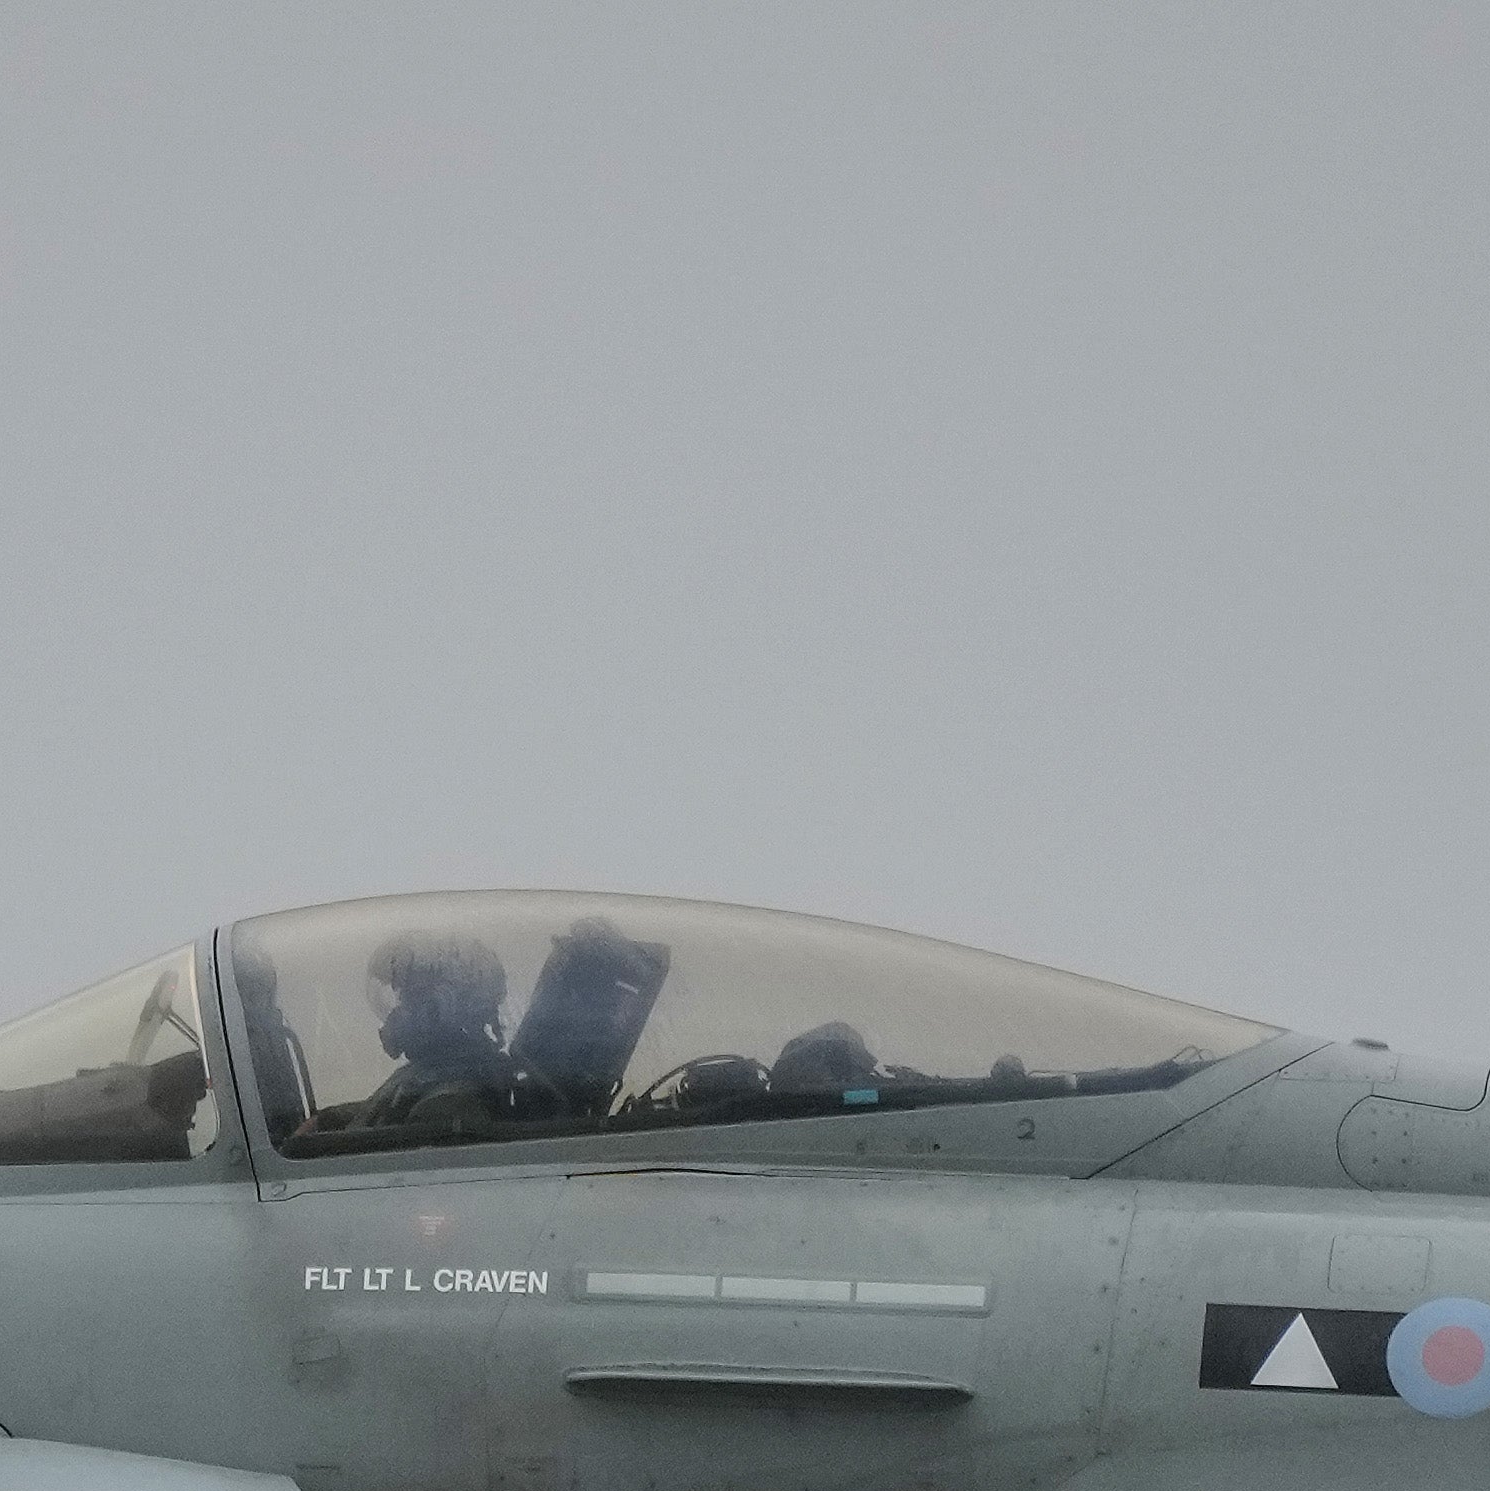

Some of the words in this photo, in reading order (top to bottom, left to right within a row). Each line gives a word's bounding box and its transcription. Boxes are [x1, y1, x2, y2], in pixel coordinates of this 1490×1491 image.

[304, 1266, 353, 1291] FLT
[363, 1267, 394, 1291] LT
[404, 1267, 422, 1292] L
[433, 1268, 549, 1295] CRAVEN
